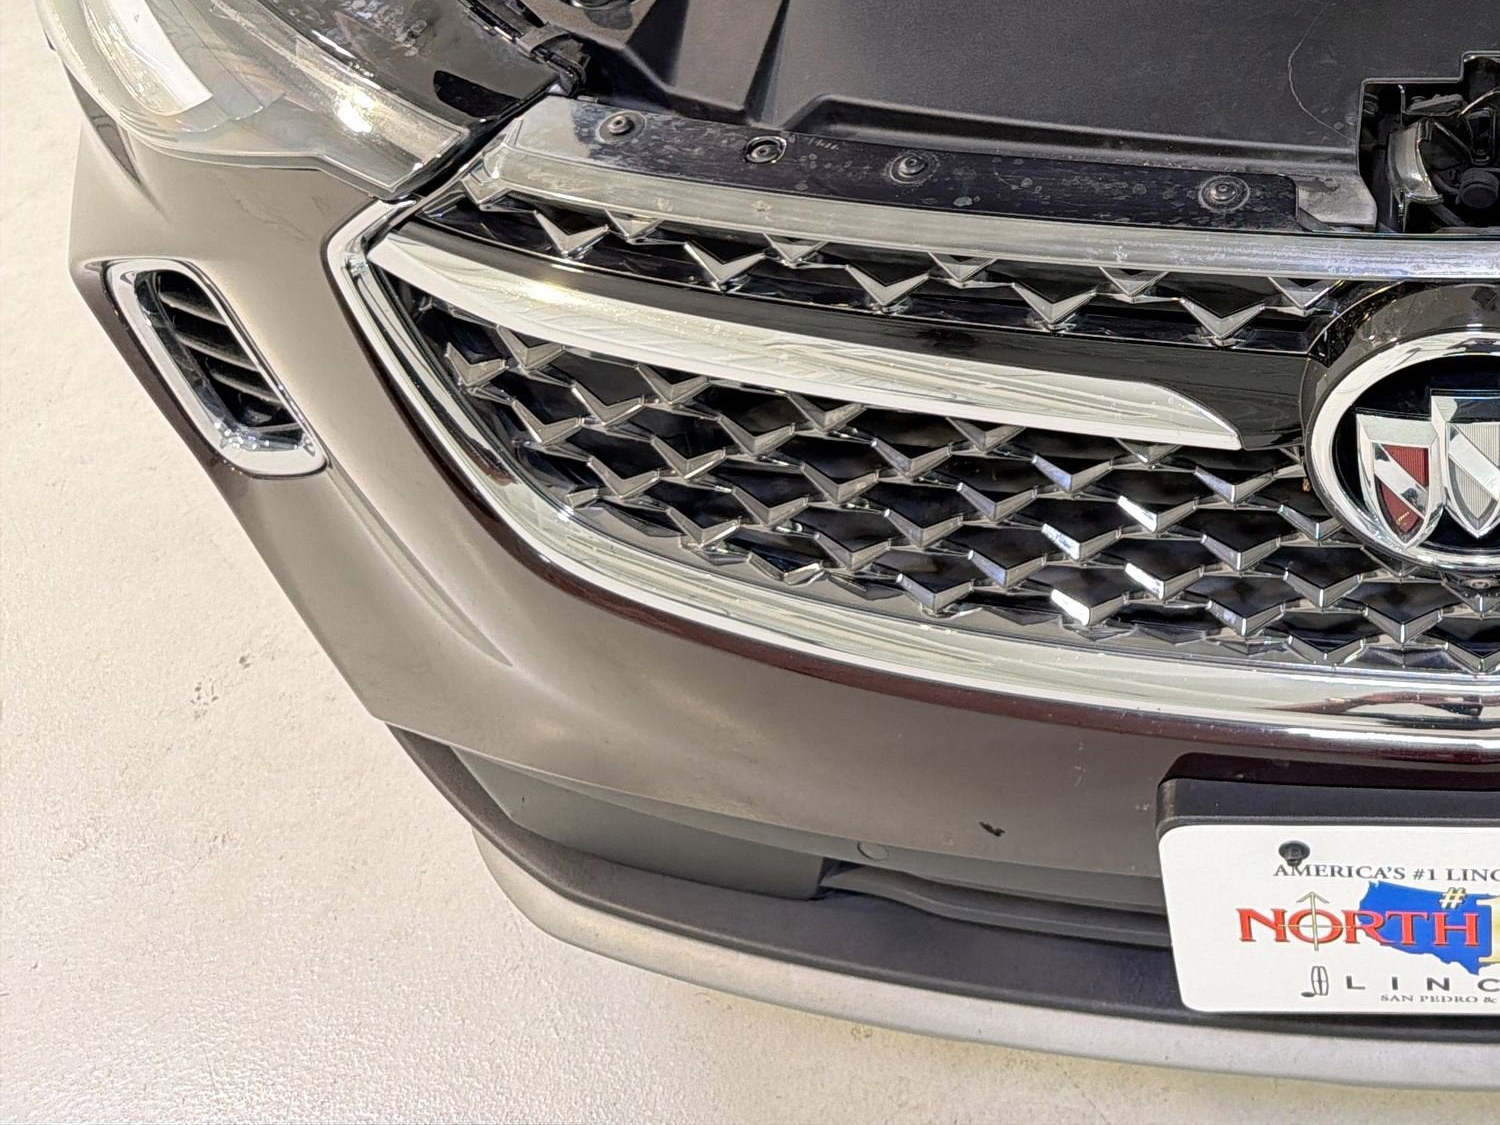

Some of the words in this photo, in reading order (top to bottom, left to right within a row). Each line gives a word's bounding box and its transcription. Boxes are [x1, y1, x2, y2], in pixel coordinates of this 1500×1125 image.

[1273, 864, 1406, 880] AMERICA'S
[1413, 868, 1436, 881] #1
[1236, 908, 1480, 948] NORTH
[1380, 994, 1414, 1003] SAN
[1419, 995, 1478, 1004] PEDRO
[1483, 995, 1498, 1004] &
